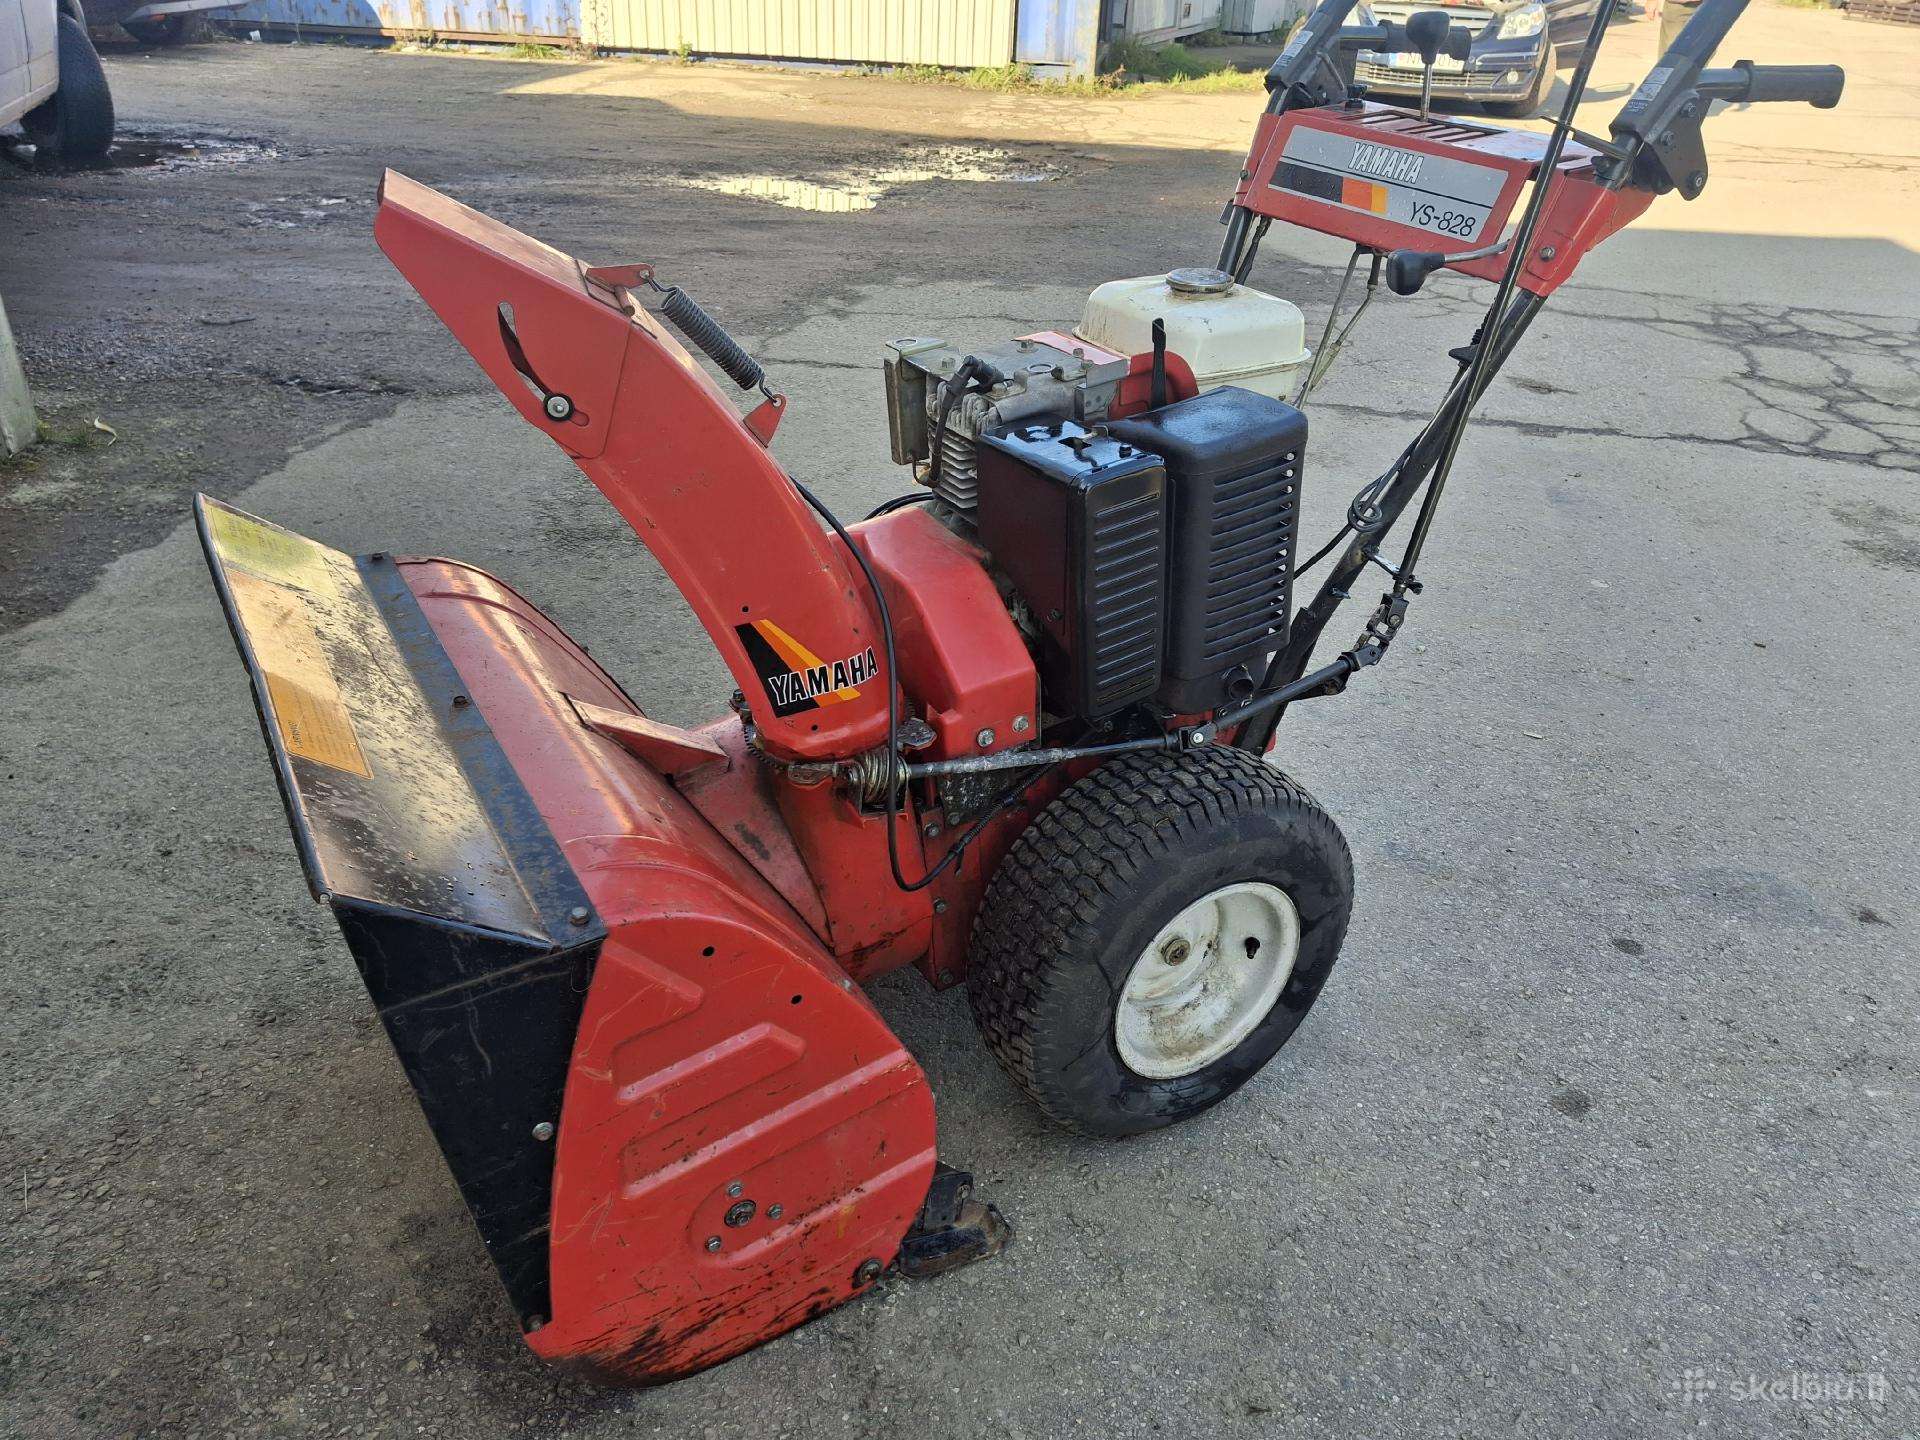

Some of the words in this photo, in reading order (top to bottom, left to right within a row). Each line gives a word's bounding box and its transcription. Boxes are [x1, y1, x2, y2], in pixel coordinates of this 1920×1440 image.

[1347, 141, 1425, 184] YAMAHA
[1409, 200, 1476, 237] YS-828
[769, 646, 879, 706] YAMAHA
